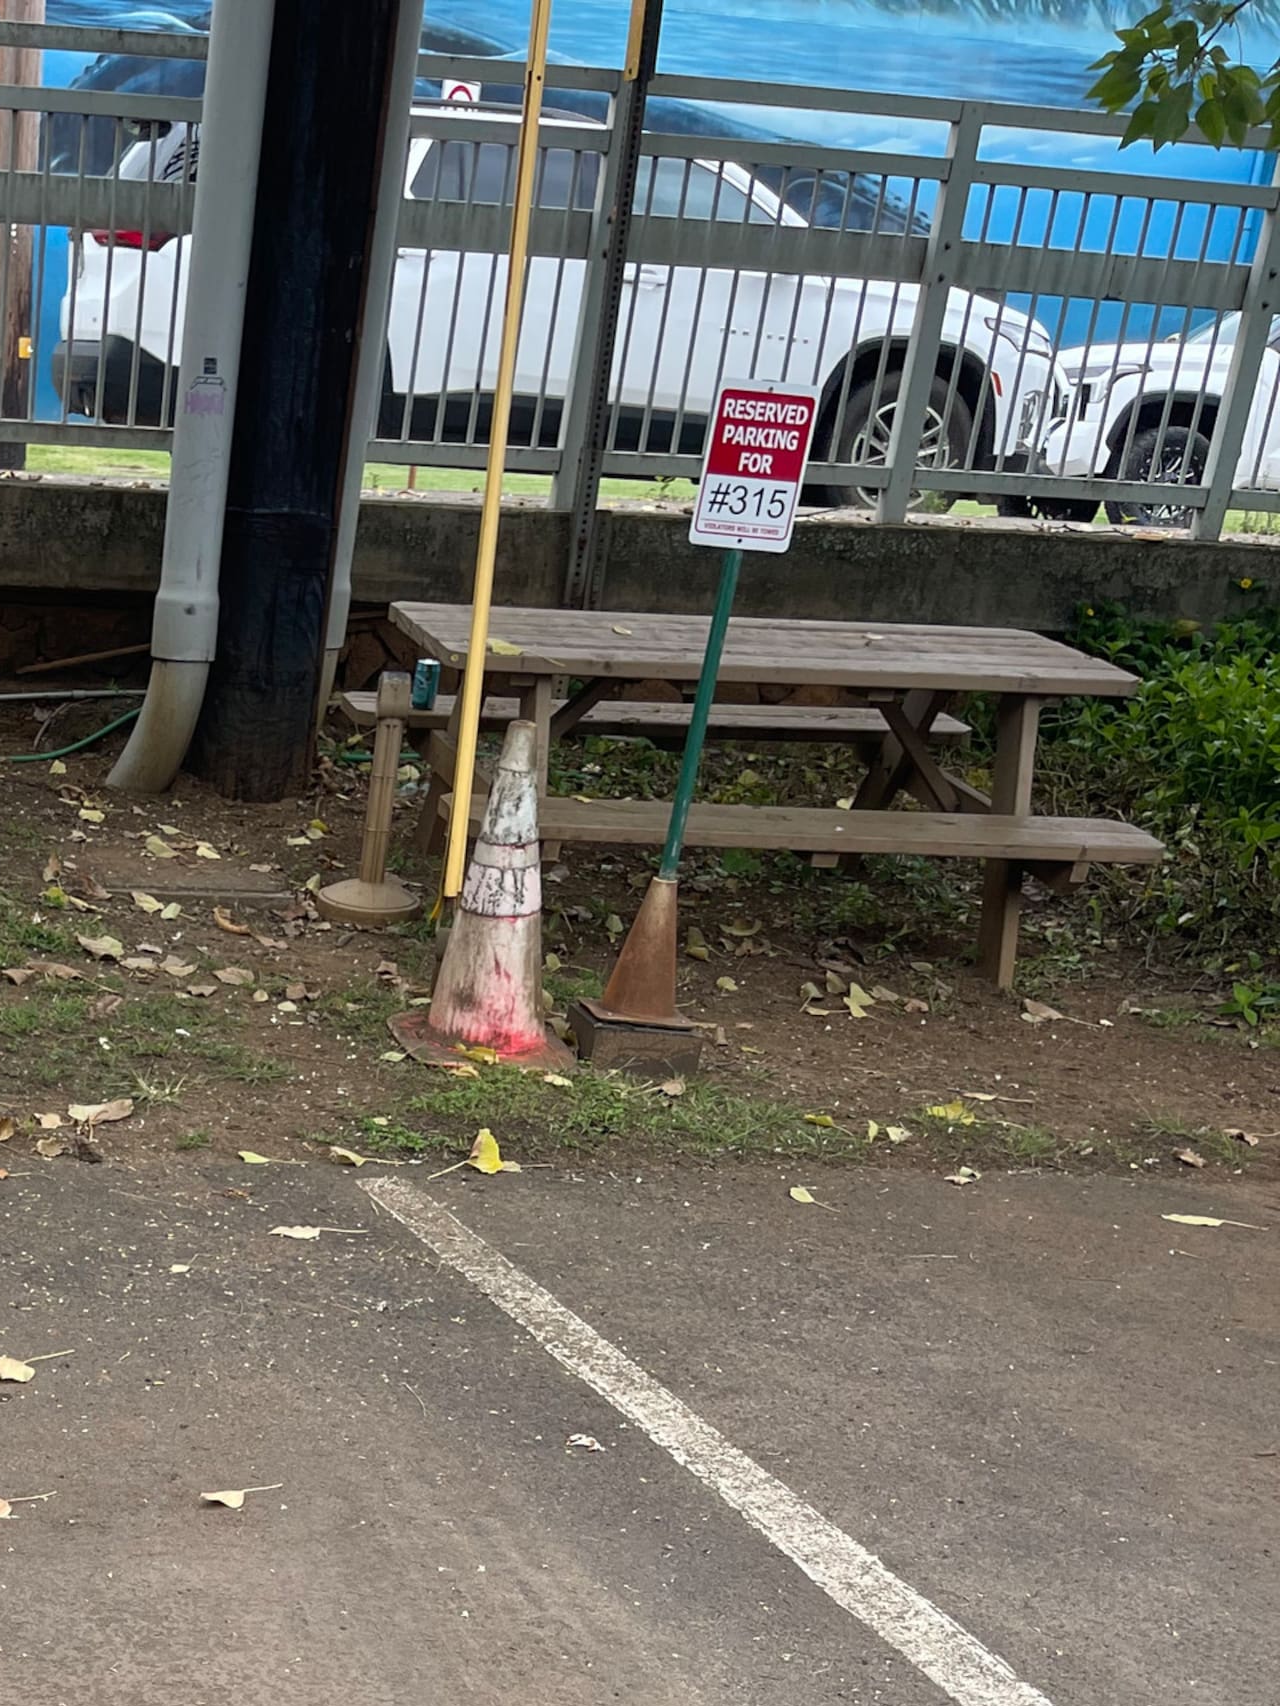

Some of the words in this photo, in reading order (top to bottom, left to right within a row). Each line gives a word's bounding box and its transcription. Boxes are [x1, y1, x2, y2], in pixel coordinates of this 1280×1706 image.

[722, 398, 809, 425] RESERVED
[722, 424, 800, 450] PARKING
[737, 452, 773, 474] FOR
[708, 482, 787, 519] #315
